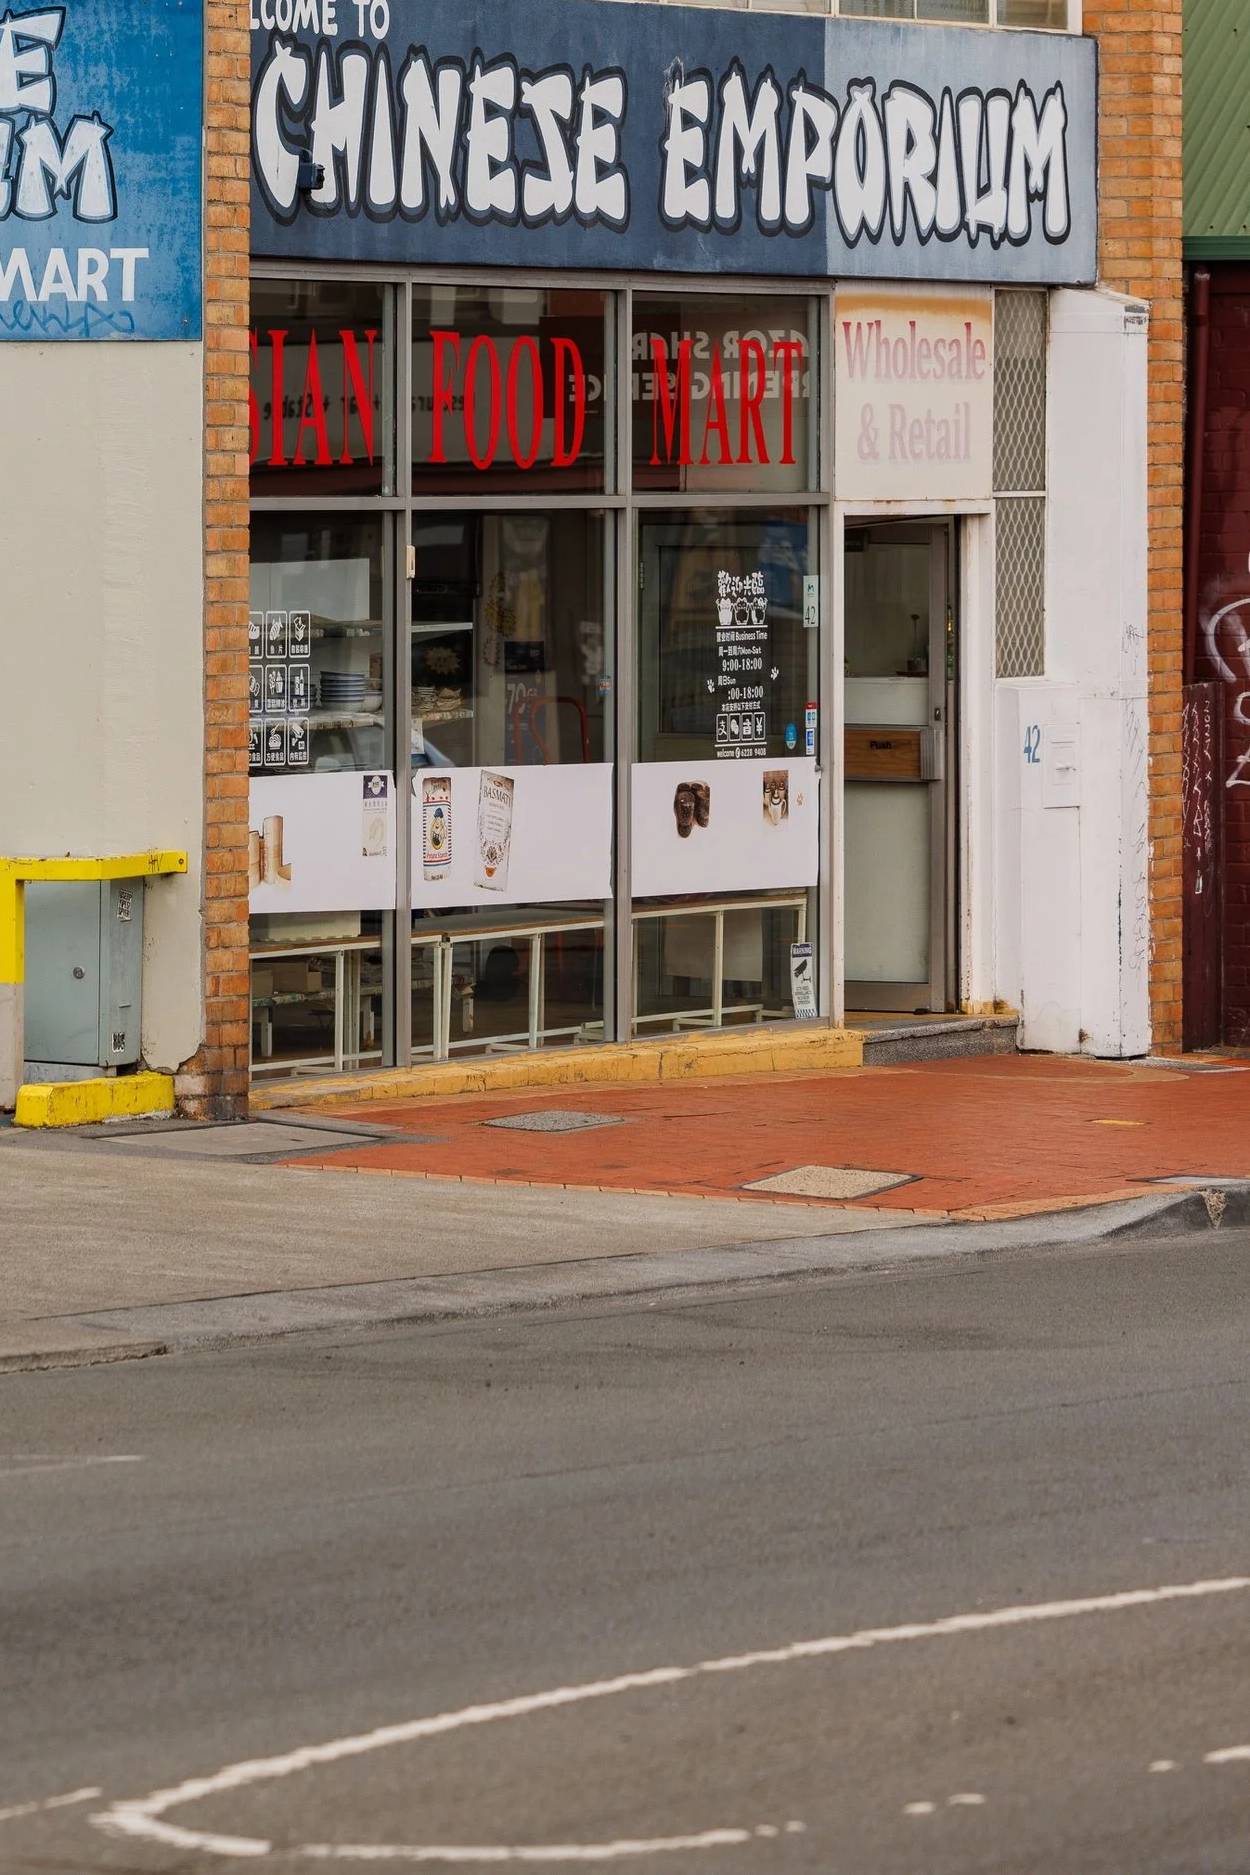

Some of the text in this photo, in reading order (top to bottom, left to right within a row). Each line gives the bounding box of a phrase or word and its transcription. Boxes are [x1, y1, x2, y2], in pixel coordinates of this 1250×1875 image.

[254, 30, 1071, 250] CHINESE EMPORIUM
[842, 319, 986, 381] Wholesale
[427, 329, 586, 471] FOOD
[649, 336, 804, 466] MART
[856, 401, 972, 461] & Retail
[805, 605, 816, 625] 42
[736, 630, 755, 641] Business
[756, 630, 768, 640] Time
[722, 657, 763, 672] 9:00-18:00
[869, 740, 892, 750] Push
[1023, 724, 1041, 764] 42
